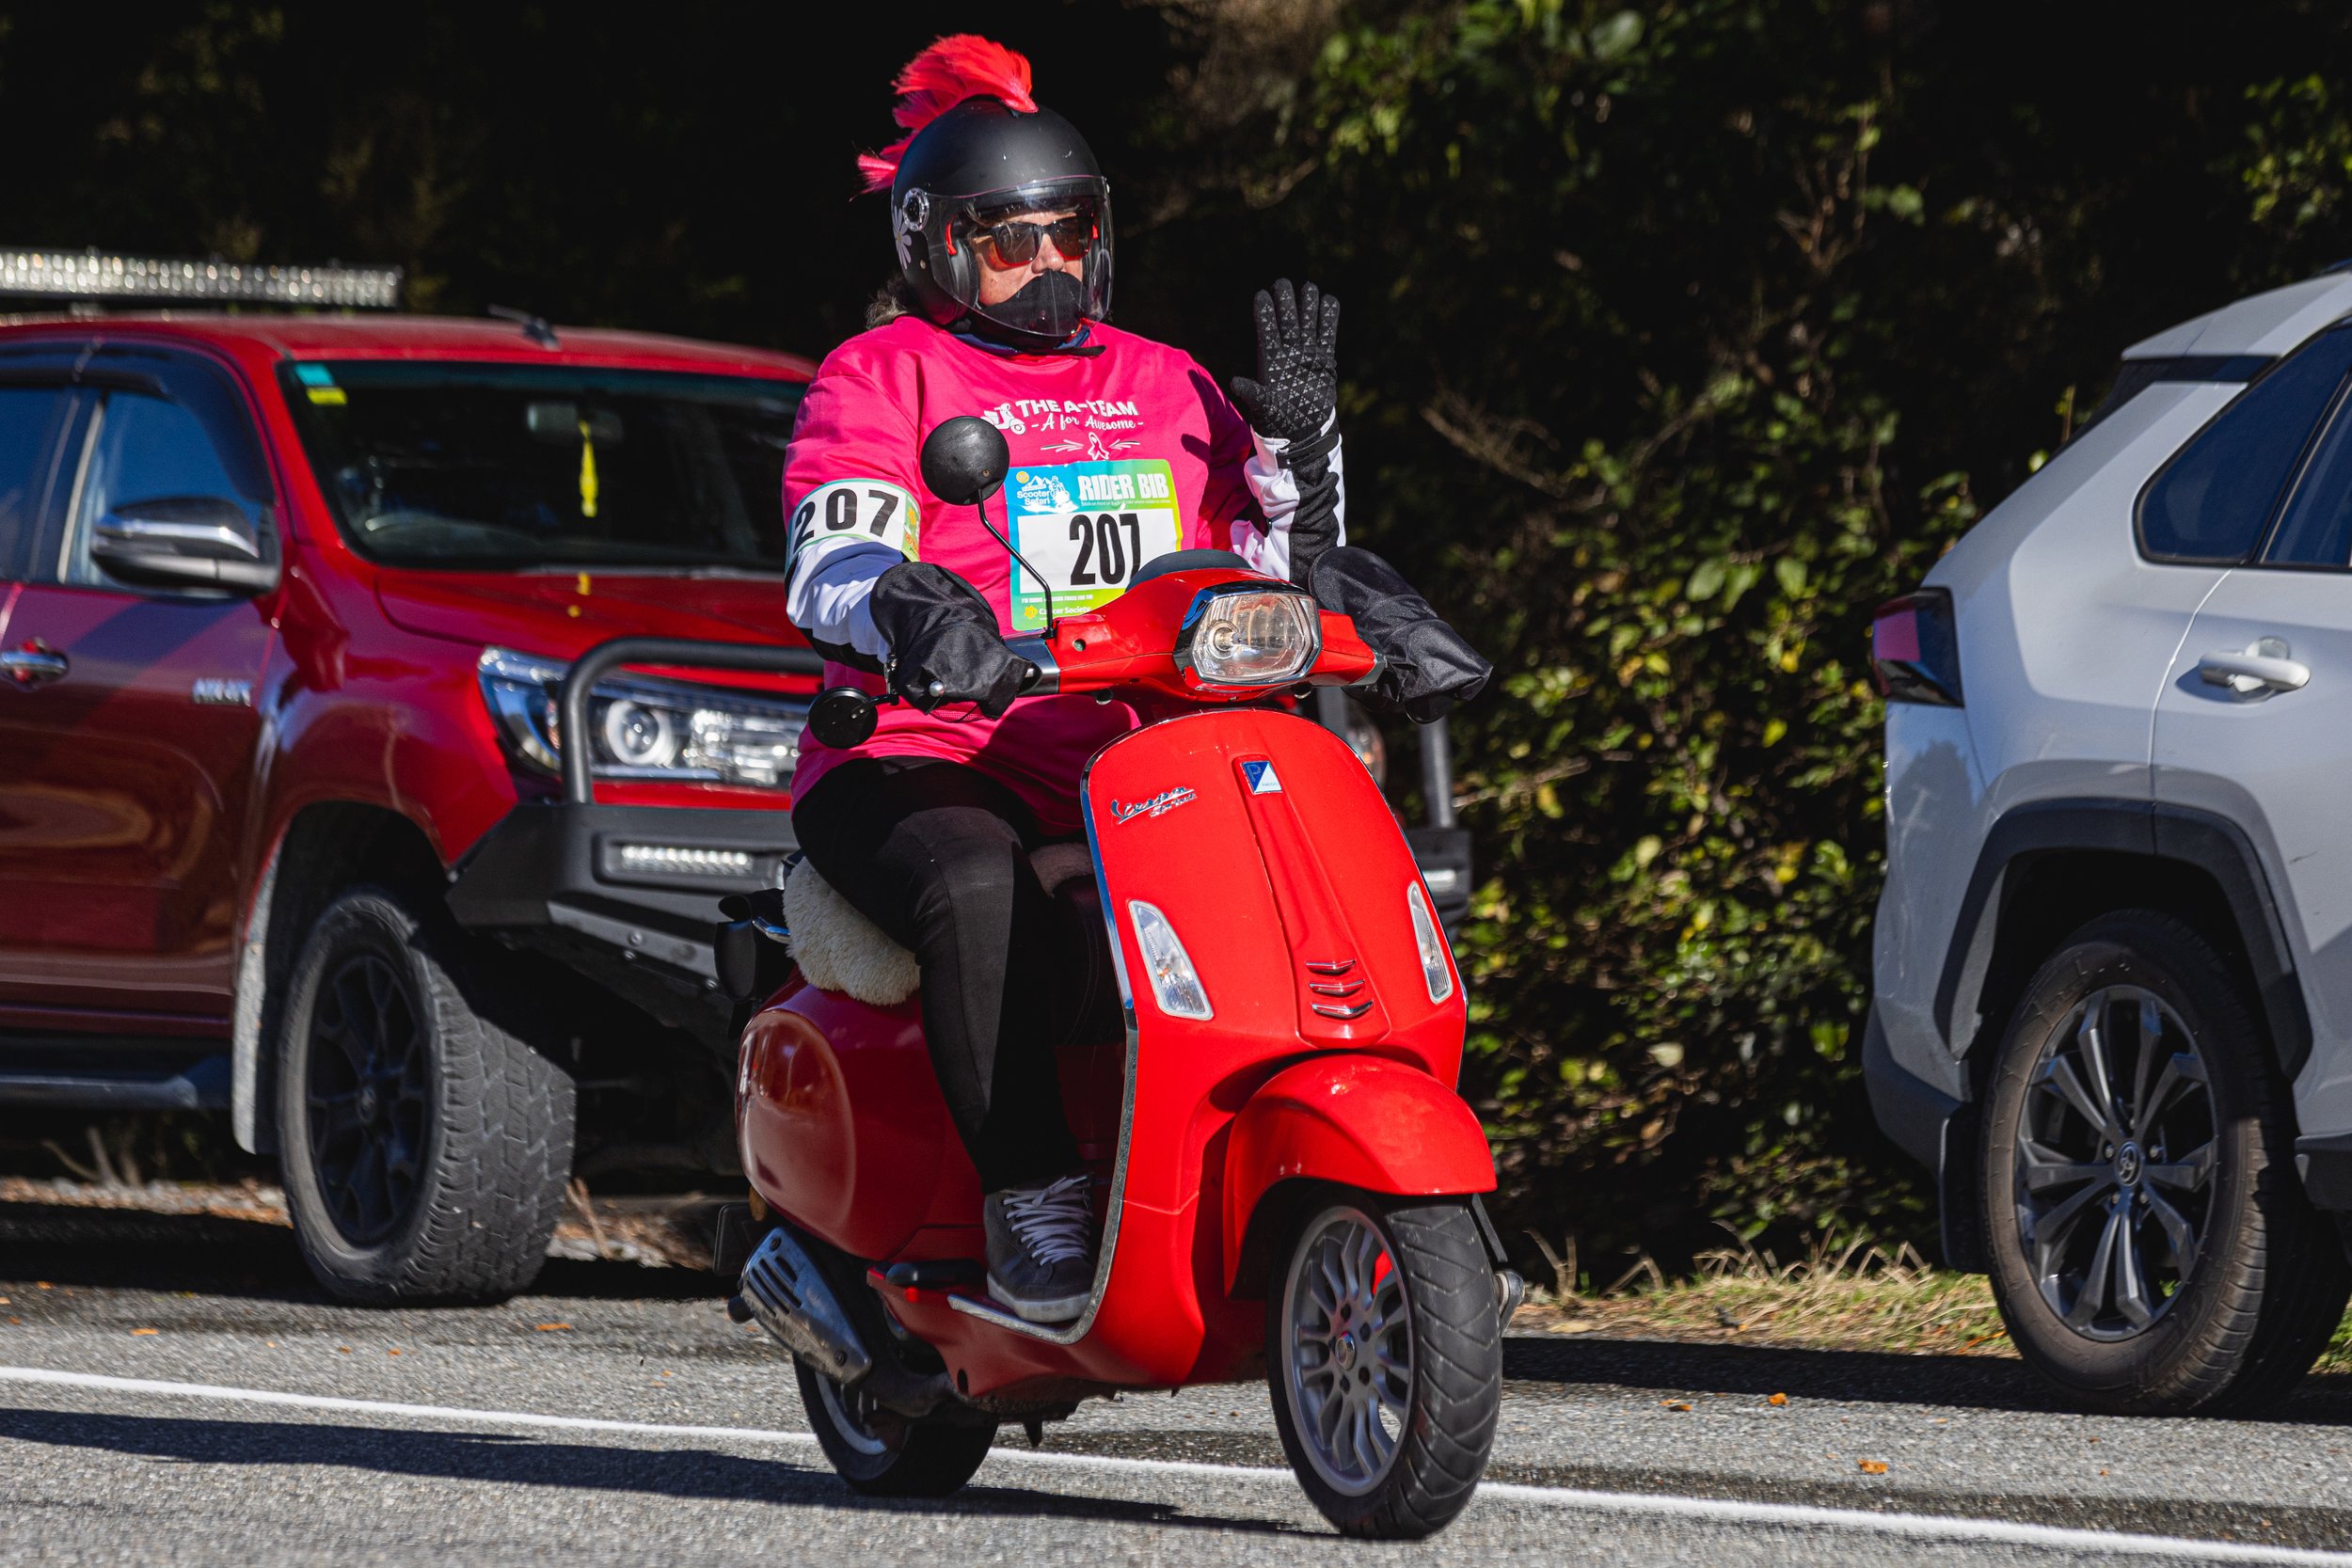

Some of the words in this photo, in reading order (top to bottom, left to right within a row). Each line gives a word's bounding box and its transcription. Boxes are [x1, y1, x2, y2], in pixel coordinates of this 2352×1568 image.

[1015, 399, 1061, 418] THE
[1063, 400, 1138, 418] A-TEAM
[1041, 412, 1055, 432] A
[1059, 414, 1080, 430] for
[1085, 415, 1136, 431] Awesome
[1016, 490, 1052, 499] Scooter
[1077, 474, 1136, 500] RIDER
[1136, 473, 1169, 499] BIB
[792, 488, 899, 554] 207
[1069, 513, 1141, 586] 207
